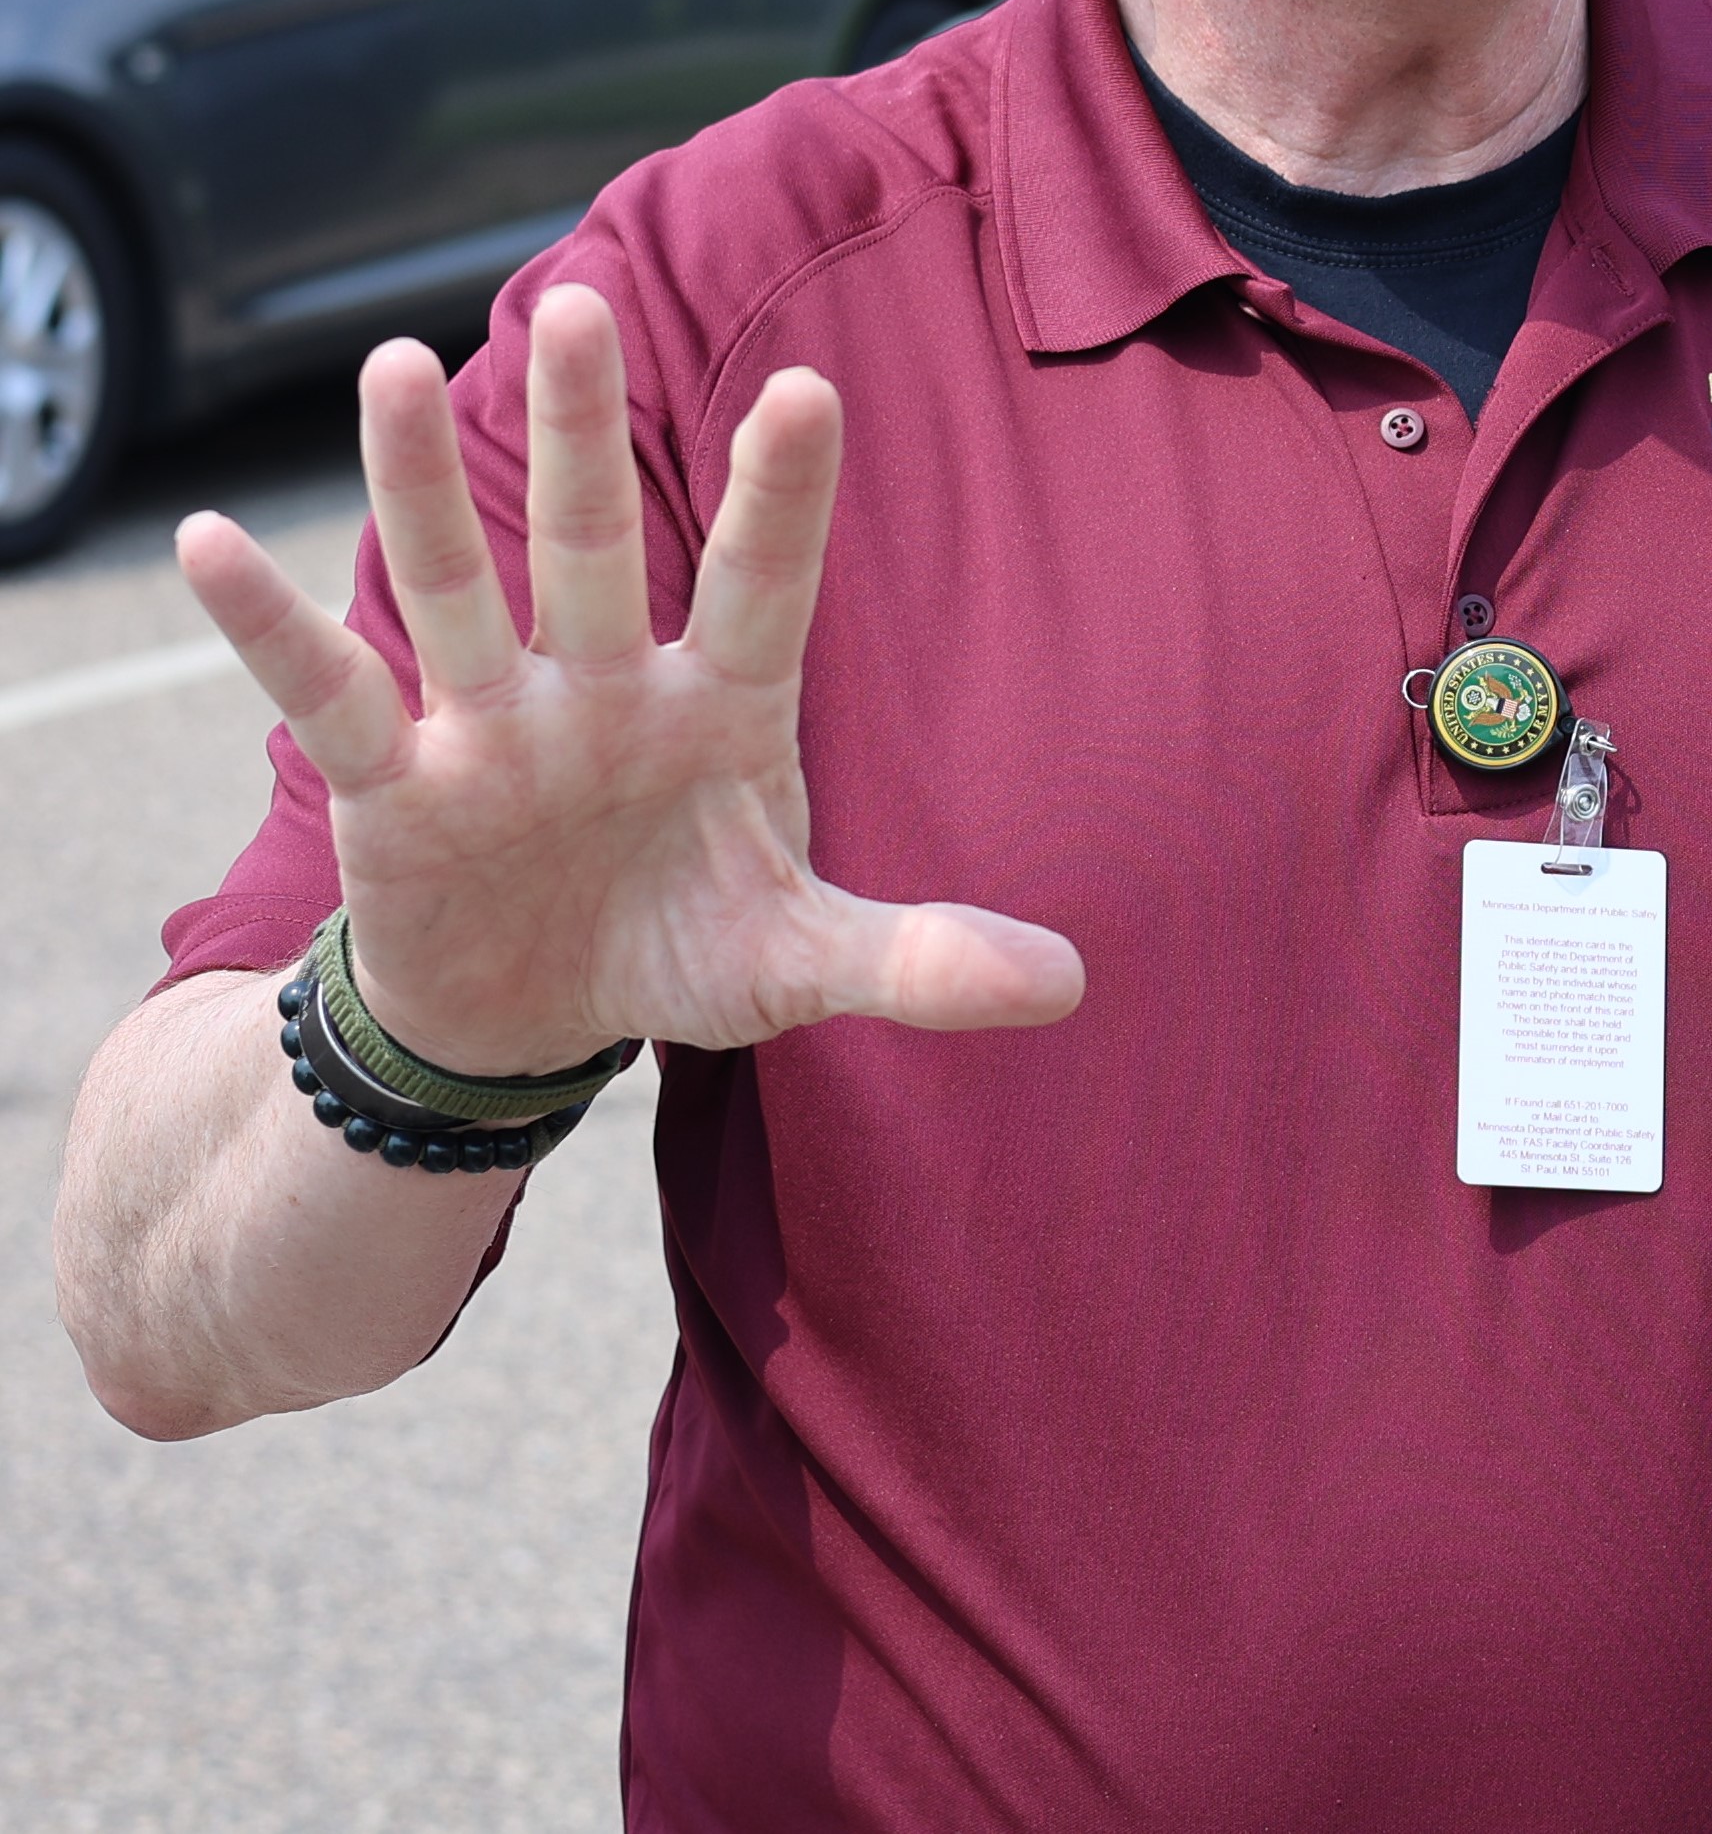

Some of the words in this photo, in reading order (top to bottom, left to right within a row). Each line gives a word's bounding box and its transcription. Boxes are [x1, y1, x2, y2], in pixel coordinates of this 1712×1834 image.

[1448, 652, 1495, 687] STATES
[1444, 691, 1469, 745] UNITED
[1527, 693, 1548, 742] ARMY
[1482, 900, 1530, 912] Minnesota
[1532, 902, 1586, 914] Department
[1588, 906, 1597, 915] of
[1600, 907, 1628, 917] Public
[1504, 934, 1524, 944] This
[1526, 937, 1583, 949] identification
[1585, 940, 1605, 950] card
[1608, 942, 1616, 951] is
[1618, 942, 1633, 951] the
[1502, 949, 1539, 959] property
[1541, 951, 1550, 959] of
[1552, 951, 1567, 961] the
[1570, 952, 1623, 965] Department
[1625, 955, 1633, 964] of
[1498, 961, 1526, 971] Public
[1529, 962, 1558, 974] Safety
[1560, 965, 1578, 974] and
[1580, 966, 1588, 975] is
[1591, 967, 1638, 978] authorized
[1499, 975, 1511, 983] for
[1513, 977, 1530, 985] use
[1533, 976, 1544, 987] by
[1546, 977, 1561, 987] the
[1563, 978, 1605, 989] individual
[1607, 981, 1637, 991] whose
[1502, 989, 1527, 998] name
[1530, 989, 1546, 999] and
[1549, 990, 1575, 1001] photo
[1577, 992, 1605, 1002] match
[1608, 994, 1633, 1004] those
[1497, 1001, 1527, 1011] shown
[1543, 1003, 1558, 1013] the
[1560, 1004, 1581, 1014] front
[1584, 1006, 1593, 1014] of
[1595, 1006, 1611, 1016] this
[1614, 1008, 1634, 1017] card
[1513, 1014, 1530, 1024] The
[1533, 1016, 1561, 1025] bearer
[1565, 1017, 1586, 1027] shall
[1588, 1019, 1600, 1028] be
[1603, 1020, 1622, 1029] held
[1502, 1028, 1555, 1039] responsible
[1557, 1030, 1569, 1039] for
[1572, 1031, 1589, 1041] this
[1591, 1032, 1612, 1042] card
[1614, 1034, 1631, 1043] and
[1515, 1041, 1538, 1050] must
[1541, 1043, 1584, 1053] surrender
[1587, 1044, 1593, 1054] it
[1595, 1046, 1618, 1056] upon
[1505, 1054, 1555, 1065] termination
[1558, 1056, 1567, 1065] of
[1570, 1057, 1624, 1069] employment
[1505, 1096, 1511, 1106] If
[1514, 1097, 1543, 1108] Found
[1546, 1100, 1561, 1109] call
[1564, 1100, 1628, 1112] 651-201-7000
[1543, 1112, 1562, 1122] Mail
[1565, 1113, 1588, 1123] Card
[1590, 1114, 1599, 1124] to
[1477, 1122, 1525, 1133] Minnesota
[1528, 1125, 1581, 1136] Department
[1583, 1128, 1593, 1137] of
[1595, 1128, 1623, 1138] Public
[1626, 1130, 1655, 1141] Safety
[1523, 1138, 1543, 1147] FAS
[1546, 1138, 1578, 1150] Facility
[1580, 1141, 1632, 1152] Coordinator
[1499, 1150, 1518, 1159] 445
[1520, 1150, 1567, 1162] Minnesota
[1588, 1155, 1612, 1164] Suite
[1615, 1156, 1632, 1165] 126
[1562, 1166, 1579, 1175] MN
[1582, 1167, 1610, 1177] 55101
